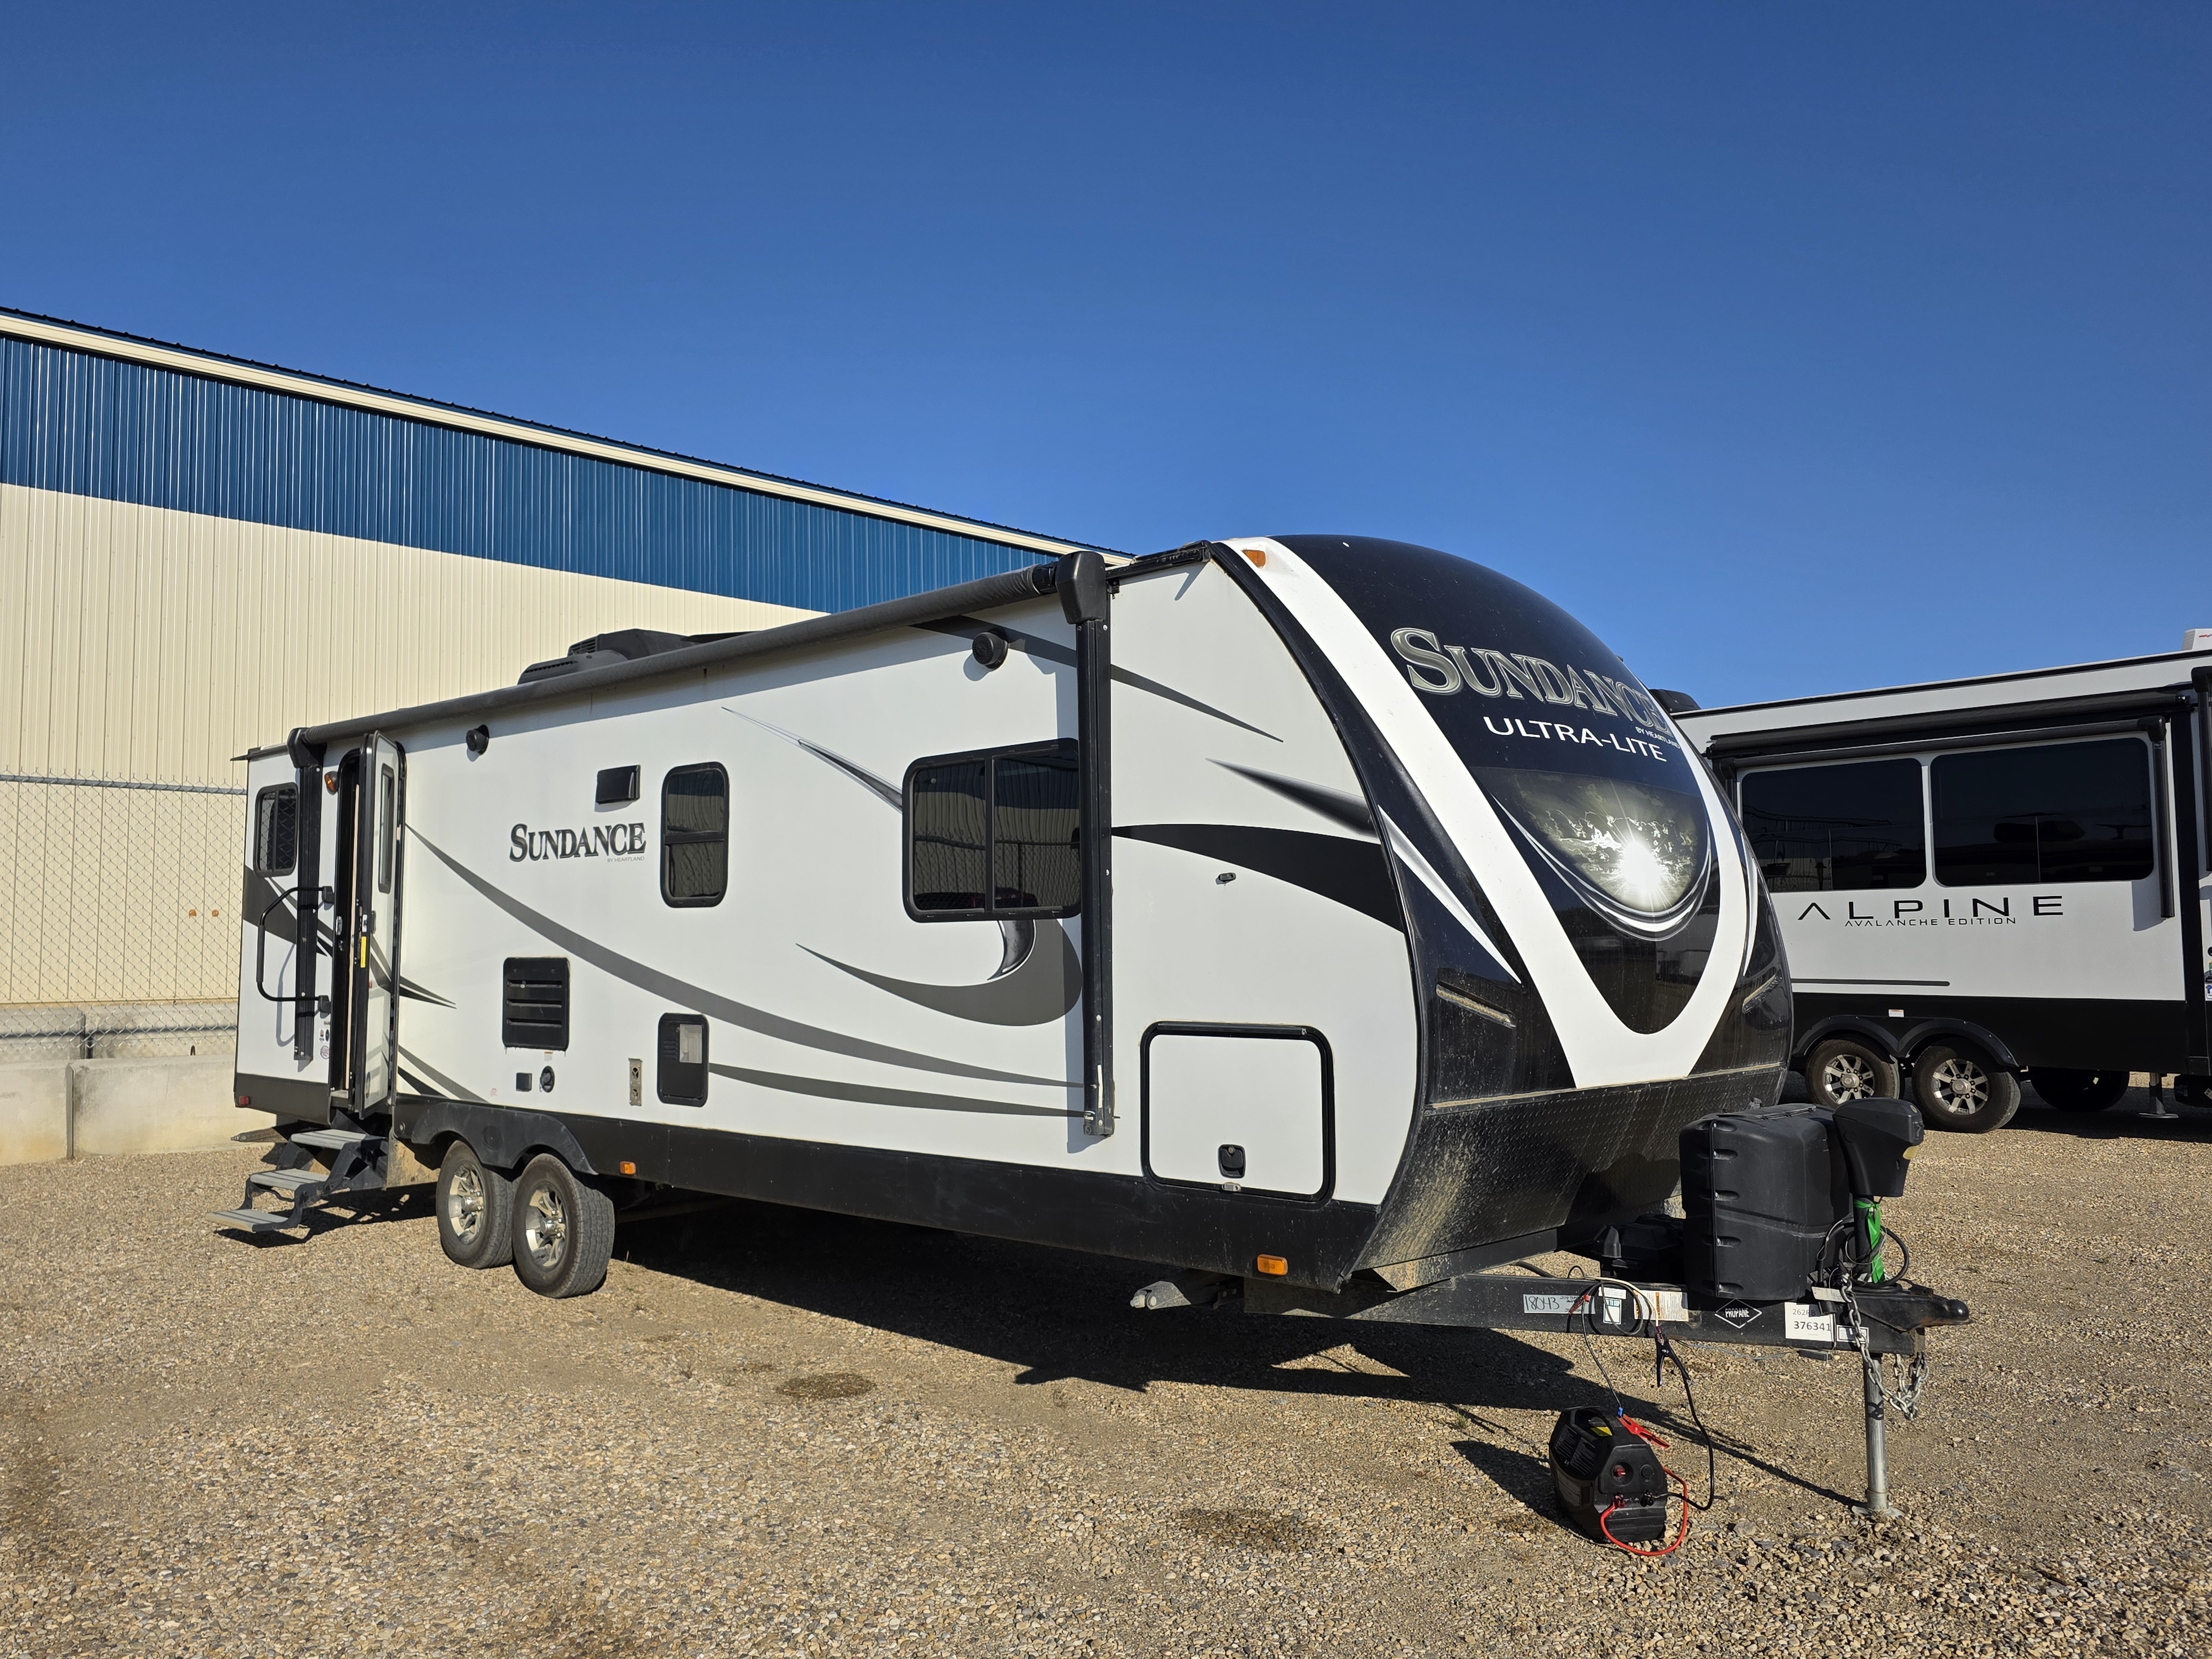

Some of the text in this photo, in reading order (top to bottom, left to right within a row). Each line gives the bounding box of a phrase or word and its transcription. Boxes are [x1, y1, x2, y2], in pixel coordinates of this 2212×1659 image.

[1390, 627, 1674, 738] SUNDANCE
[1635, 726, 1645, 735] BY
[1483, 716, 1667, 762] ULTRA-LITE
[509, 822, 646, 863] SUNDANCE
[1798, 895, 2063, 920] ALPINE
[1845, 917, 2016, 927] AVALANCHE EDITION
[1525, 1295, 1559, 1311] 18043
[1725, 1307, 1750, 1318] PROPANE
[1793, 1321, 1832, 1332] 376341
